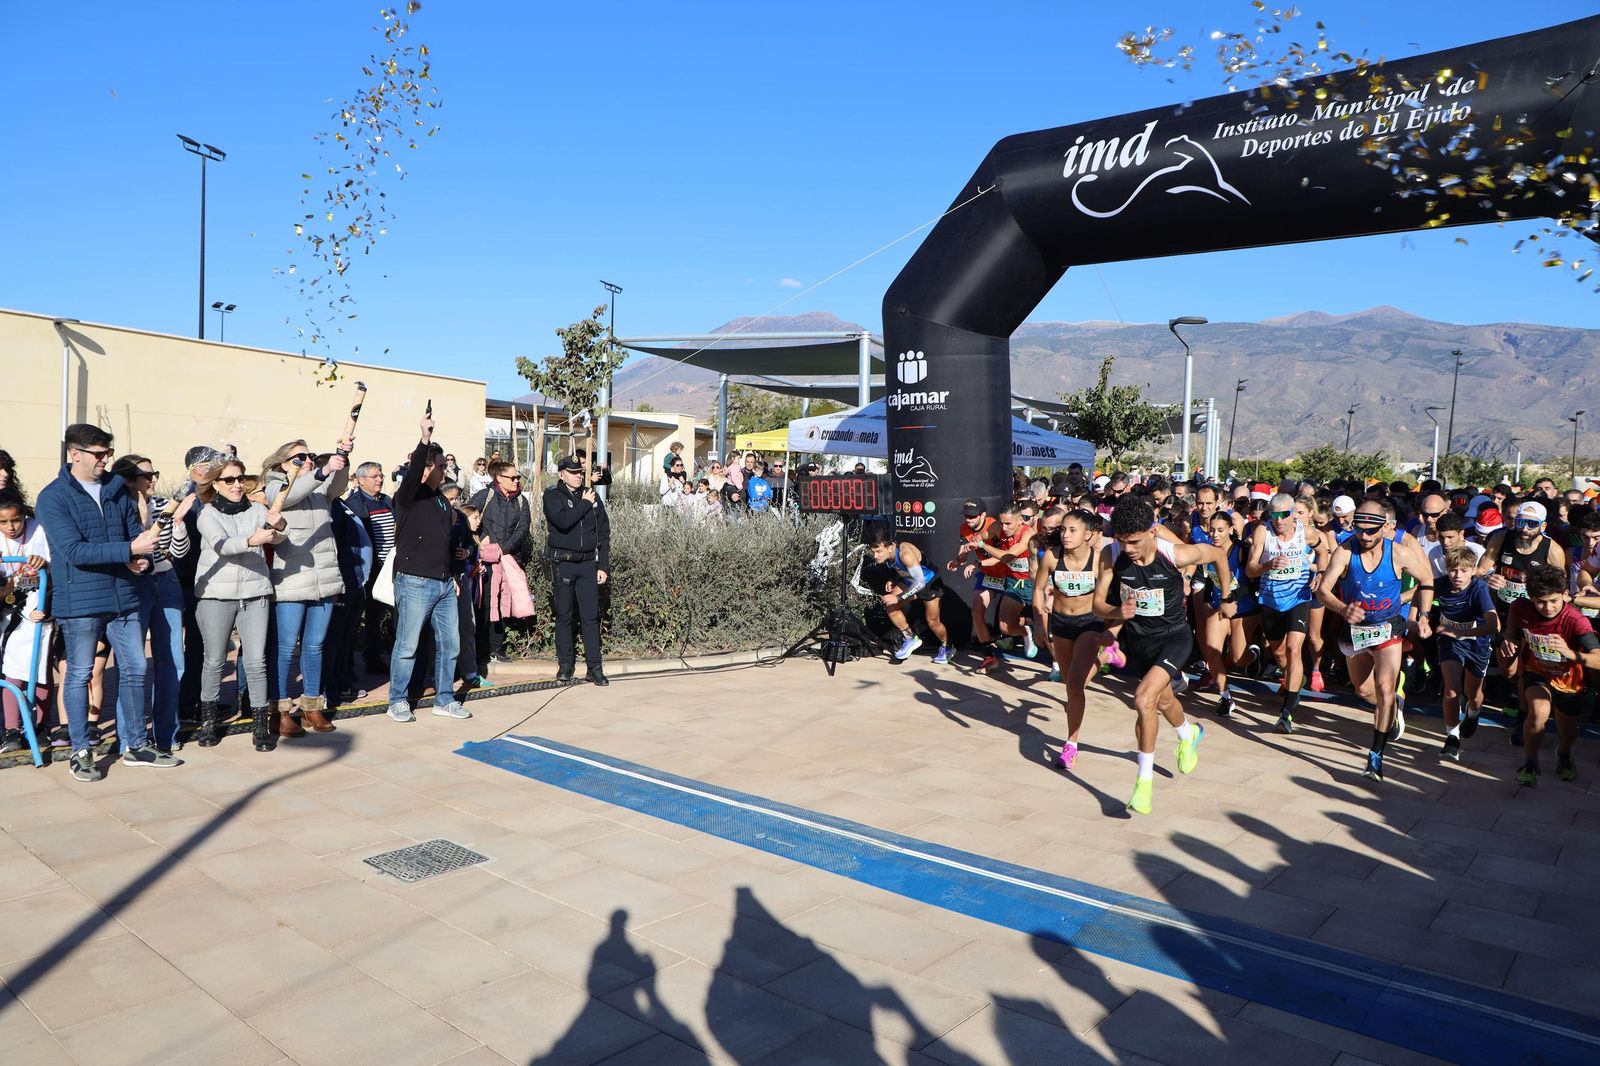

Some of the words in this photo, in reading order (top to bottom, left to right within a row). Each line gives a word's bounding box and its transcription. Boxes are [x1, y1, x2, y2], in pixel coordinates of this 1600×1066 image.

[1212, 112, 1298, 140] Instituto
[1310, 83, 1431, 122] Municipal
[1445, 76, 1476, 98] de
[1239, 128, 1333, 159] Deportes
[1339, 120, 1364, 141] de
[1371, 112, 1399, 136] El
[1403, 101, 1472, 133] Ejido
[1062, 119, 1159, 178] imd
[888, 388, 950, 411] cajamar
[909, 404, 926, 412] CAJA
[926, 403, 948, 411] RURAL
[893, 447, 914, 465] imd
[895, 515, 904, 527] EL
[905, 515, 937, 528] EJIDO
[1277, 567, 1296, 575] 203
[1067, 582, 1081, 591] 81
[1505, 590, 1527, 600] 326
[1359, 630, 1381, 641] 119
